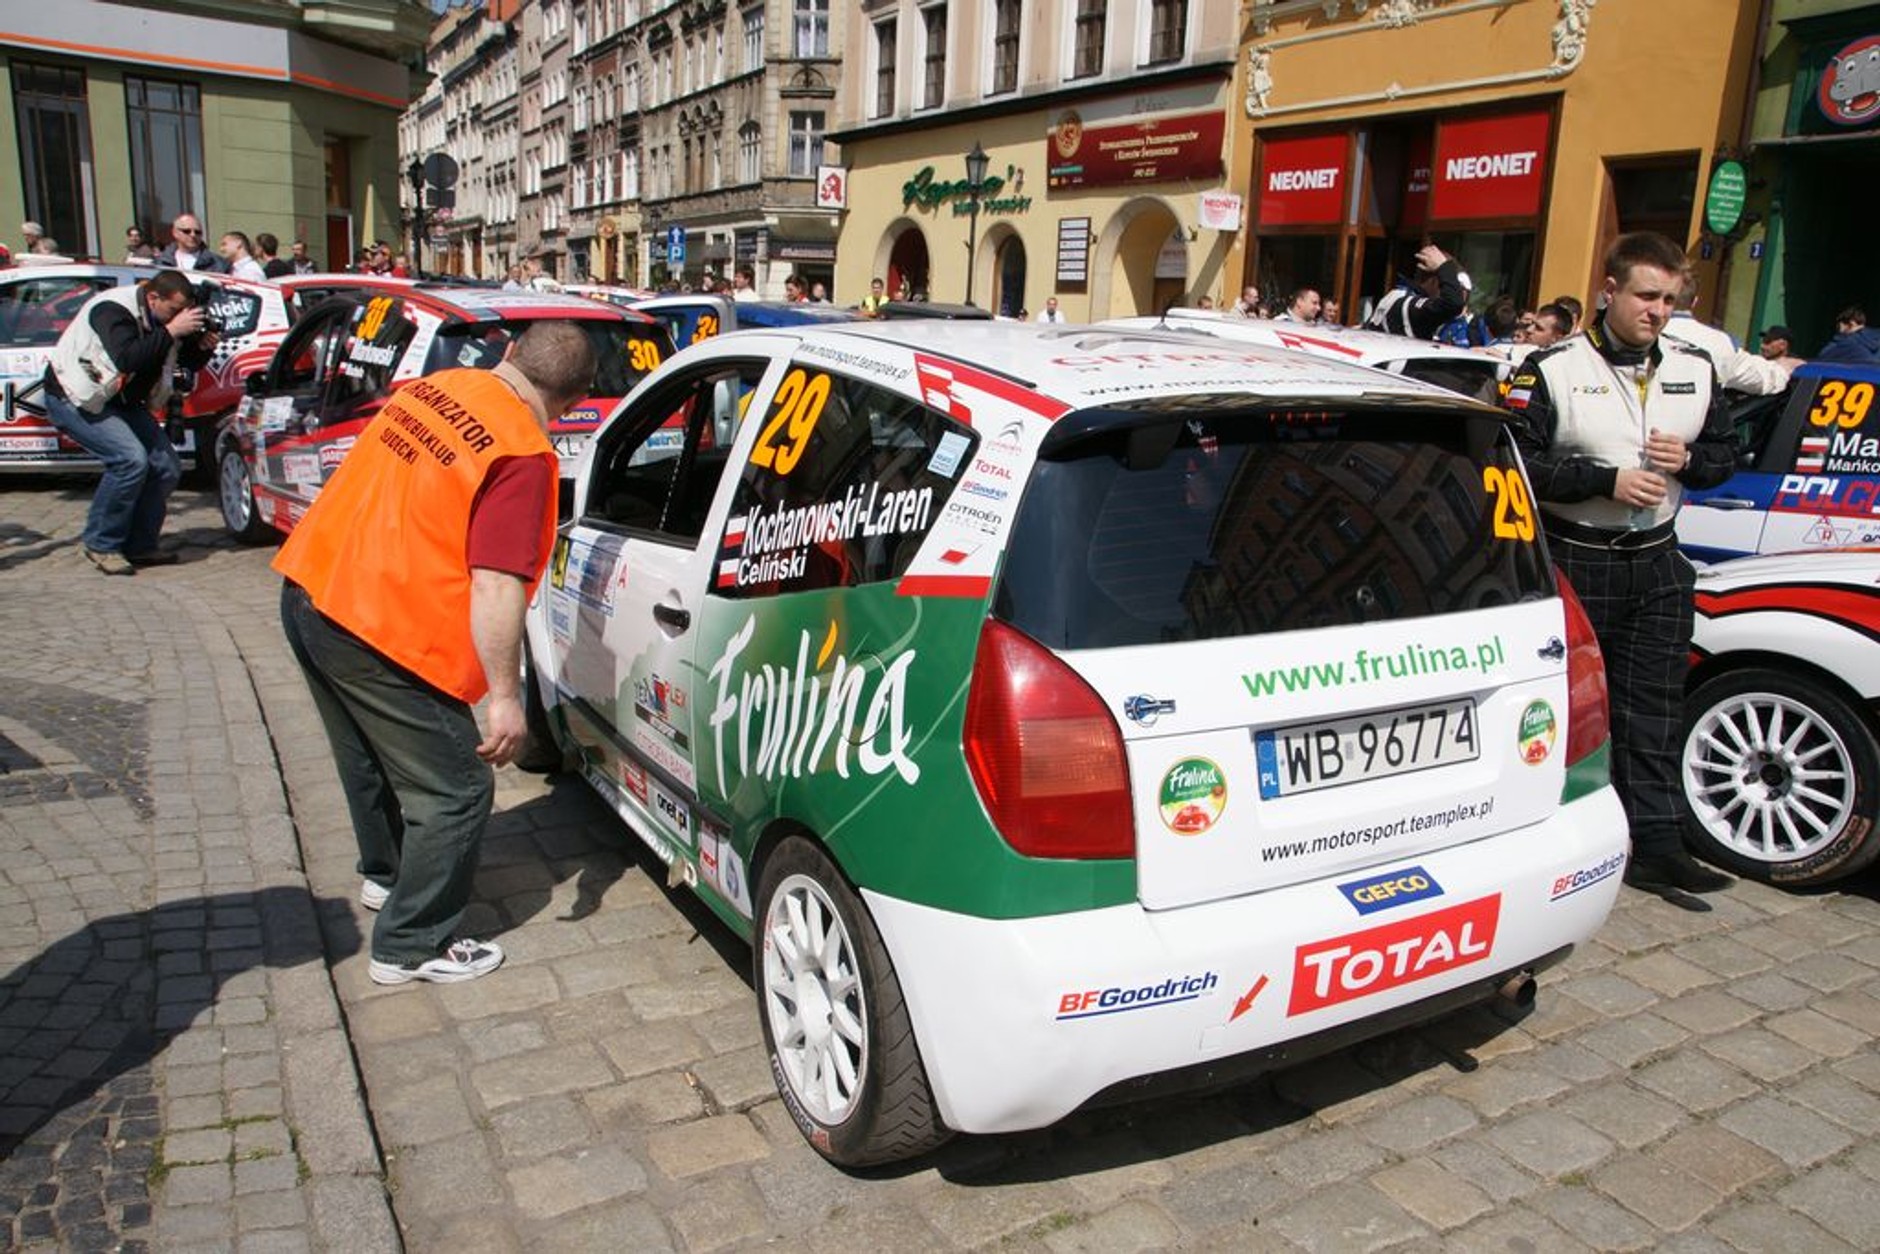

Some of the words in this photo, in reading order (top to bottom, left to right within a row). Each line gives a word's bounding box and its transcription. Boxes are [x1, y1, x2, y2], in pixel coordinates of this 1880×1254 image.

[1269, 168, 1339, 192] NEONET
[1446, 151, 1537, 181] NEONET
[627, 339, 661, 371] 30
[750, 369, 832, 475] 29
[1809, 380, 1875, 428] 39
[1831, 432, 1880, 457] Ma
[975, 458, 1012, 480] TOTAL
[743, 481, 933, 556] Kochanowski-Laren
[1482, 466, 1535, 542] 29
[737, 549, 806, 586] Celiński
[1241, 635, 1506, 698] www.frulina.pl
[707, 613, 921, 802] Frulina
[1283, 729, 1344, 786] WB
[1357, 705, 1475, 772] 96774
[1169, 765, 1219, 793] Frulina
[1261, 772, 1279, 787] PL
[1261, 797, 1496, 863] www.motorsport.teamplex.pl
[1352, 874, 1430, 905] GEFCO
[1551, 852, 1626, 895] BFGoodrich
[1303, 921, 1488, 999] TOTAL
[1057, 970, 1218, 1015] BFGoodrich
